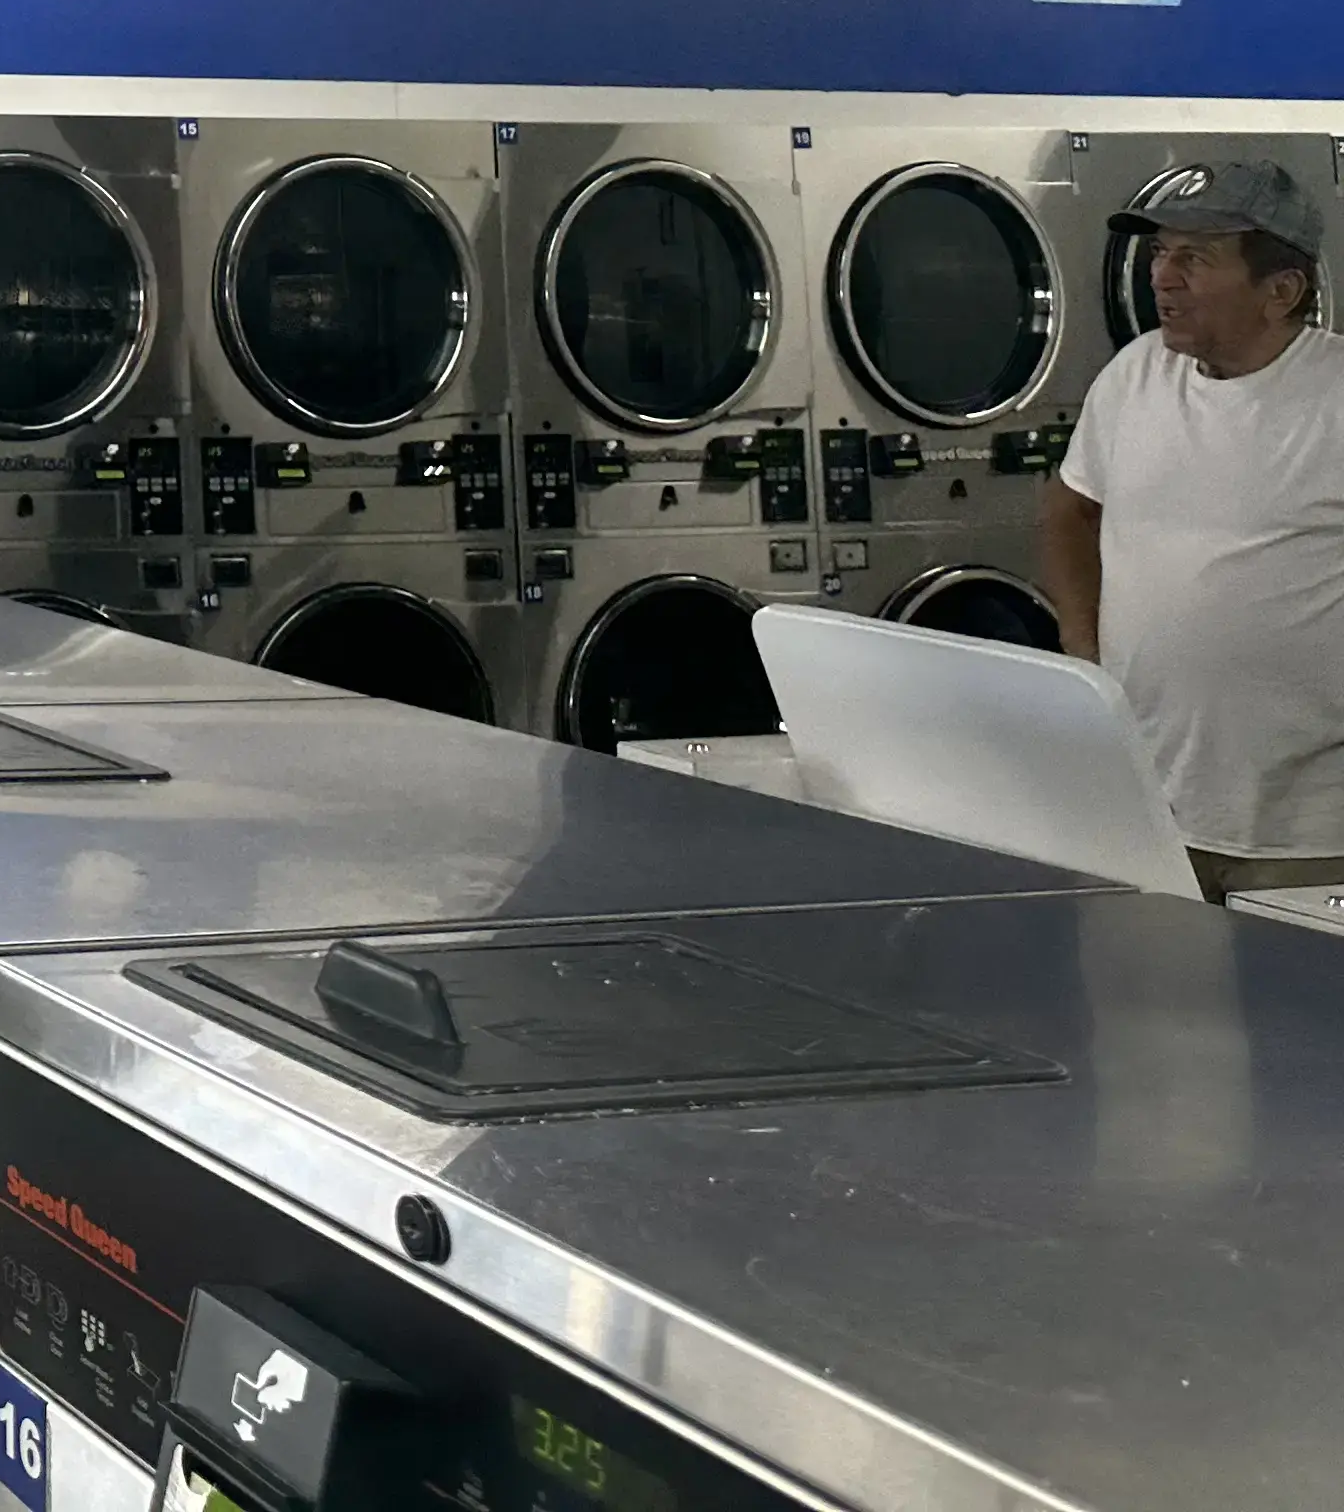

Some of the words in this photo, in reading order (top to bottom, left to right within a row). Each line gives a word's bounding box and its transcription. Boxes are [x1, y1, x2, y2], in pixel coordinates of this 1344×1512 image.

[179, 123, 197, 135] 15
[500, 128, 515, 139] 17
[1073, 136, 1087, 148] 21
[7, 1165, 67, 1230] Speed
[70, 1204, 136, 1274] Queen
[0, 1401, 41, 1479] 16
